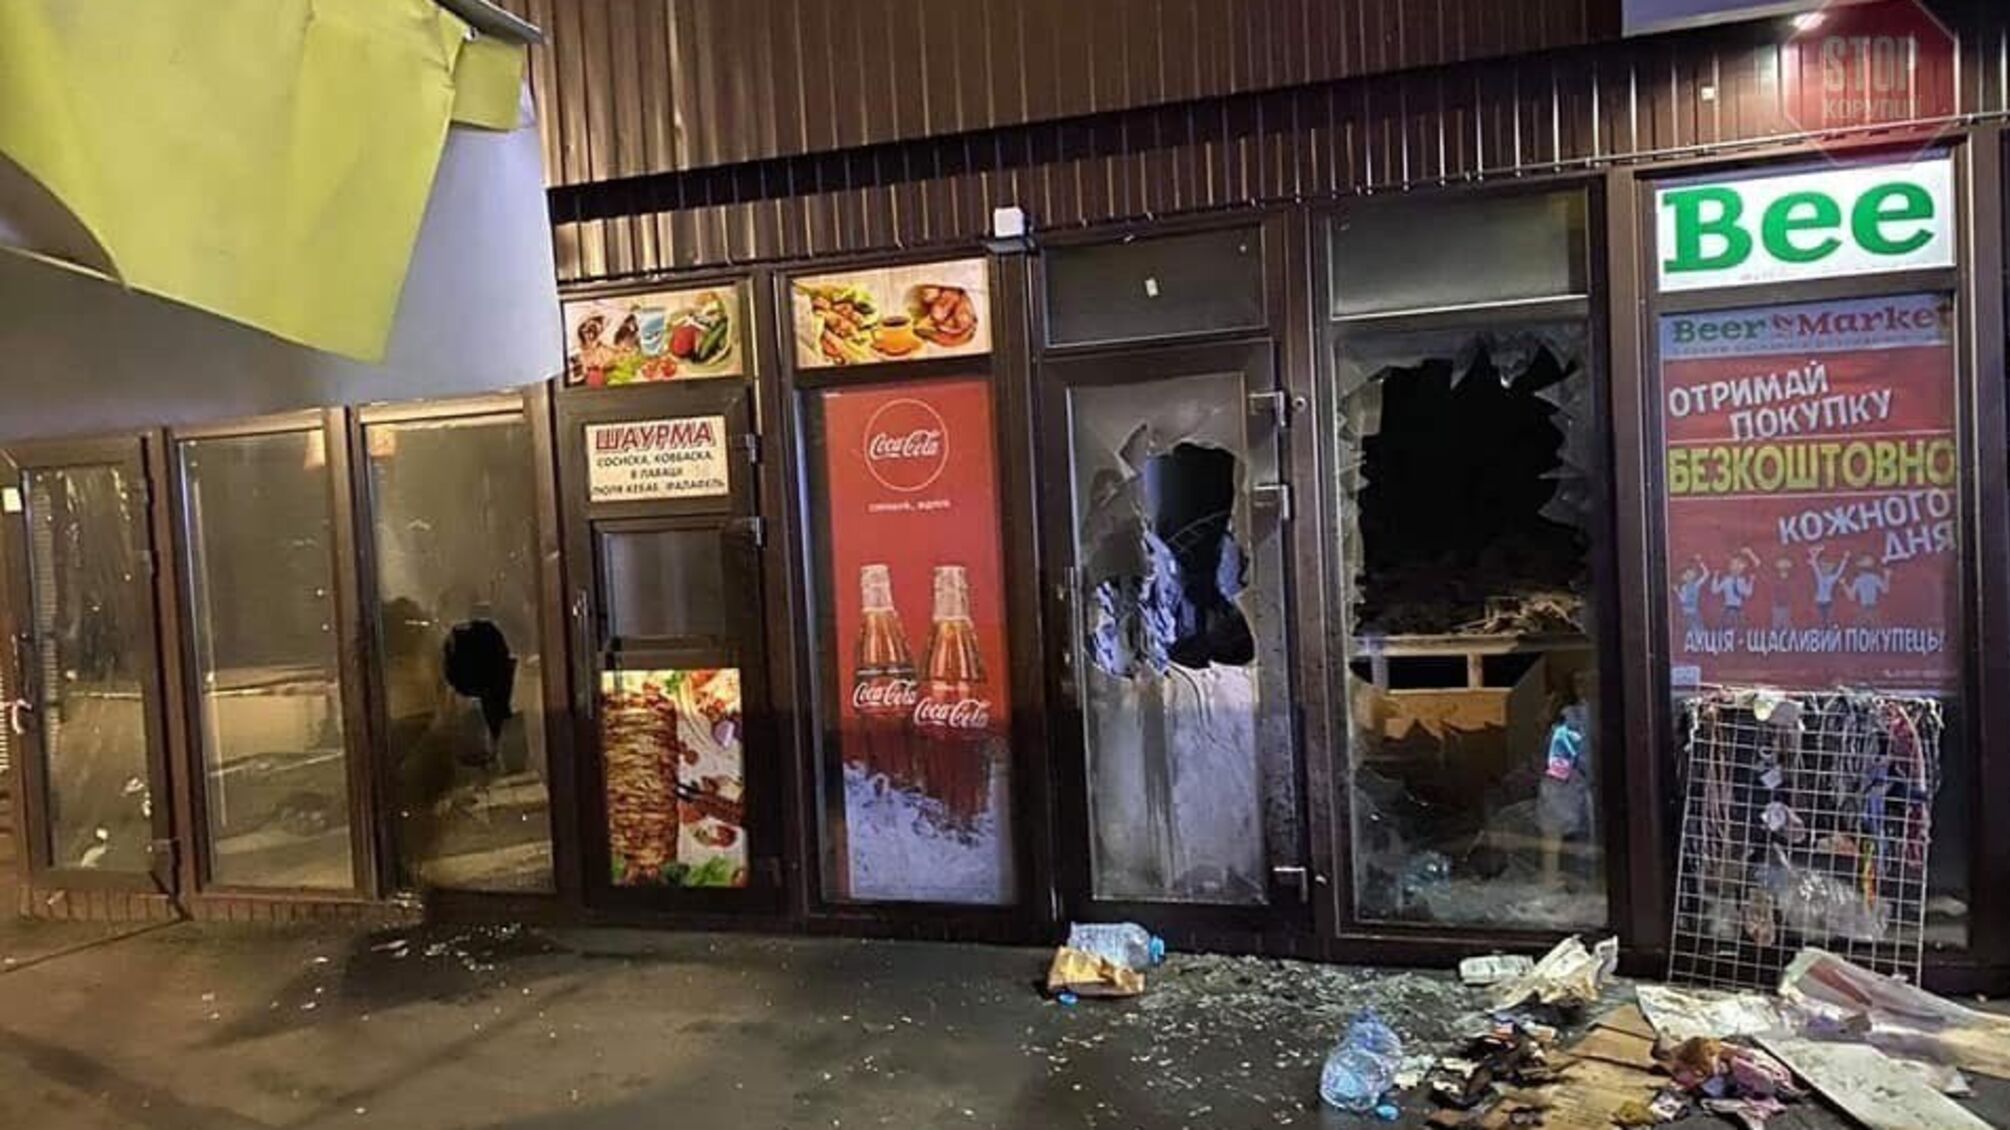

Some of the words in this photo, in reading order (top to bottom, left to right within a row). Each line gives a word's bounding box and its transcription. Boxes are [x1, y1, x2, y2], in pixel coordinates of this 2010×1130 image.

[1663, 182, 1934, 273] Bee
[1673, 318, 1766, 343] Beer
[1669, 361, 1829, 416] ОТРИМАЙ
[1730, 390, 1891, 441] ПОКУПКУ
[596, 421, 716, 452] ШАУРМА
[870, 430, 940, 460] Coca-Cola
[1668, 438, 1955, 494] БЕЗКОШТОВНО
[1779, 488, 1950, 544] КОЖНОГО
[1881, 520, 1955, 564] ДНЯ
[1684, 629, 1735, 655] АКЦІЯ
[1747, 624, 1841, 656] ЩАСЛИВИЙ
[853, 679, 918, 708] Coca-Cola
[914, 697, 991, 729] Coca-Cola
